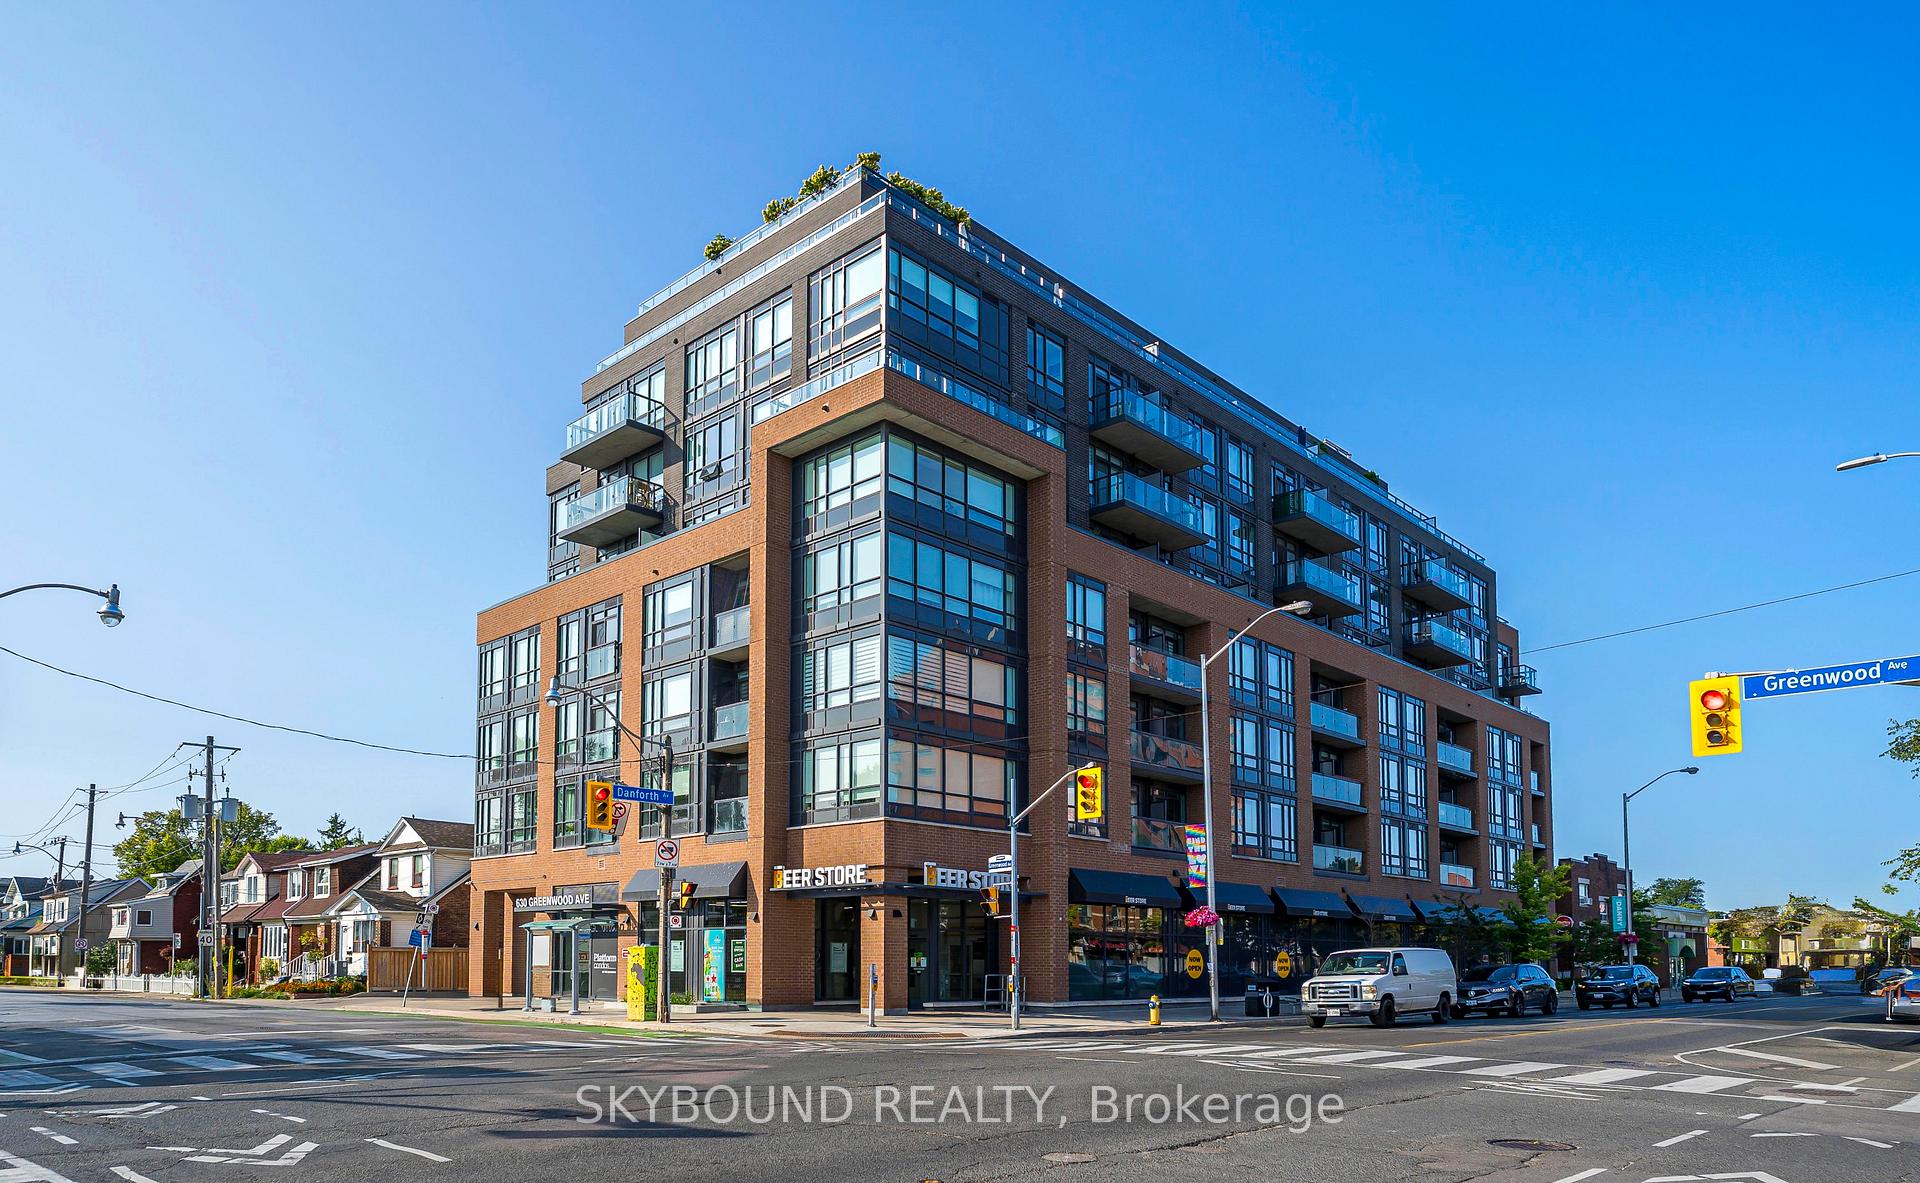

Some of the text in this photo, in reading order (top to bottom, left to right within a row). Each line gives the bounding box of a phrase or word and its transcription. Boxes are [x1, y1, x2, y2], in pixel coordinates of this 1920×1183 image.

[1763, 660, 1908, 692] Greenwood Ave
[617, 787, 659, 801] Danforth
[773, 864, 867, 889] BEER STORE
[923, 861, 1012, 892] BEER STOR
[515, 893, 590, 908] 630 GREENWOOD AVE
[1615, 901, 1623, 926] DANNY
[200, 935, 212, 944] 40
